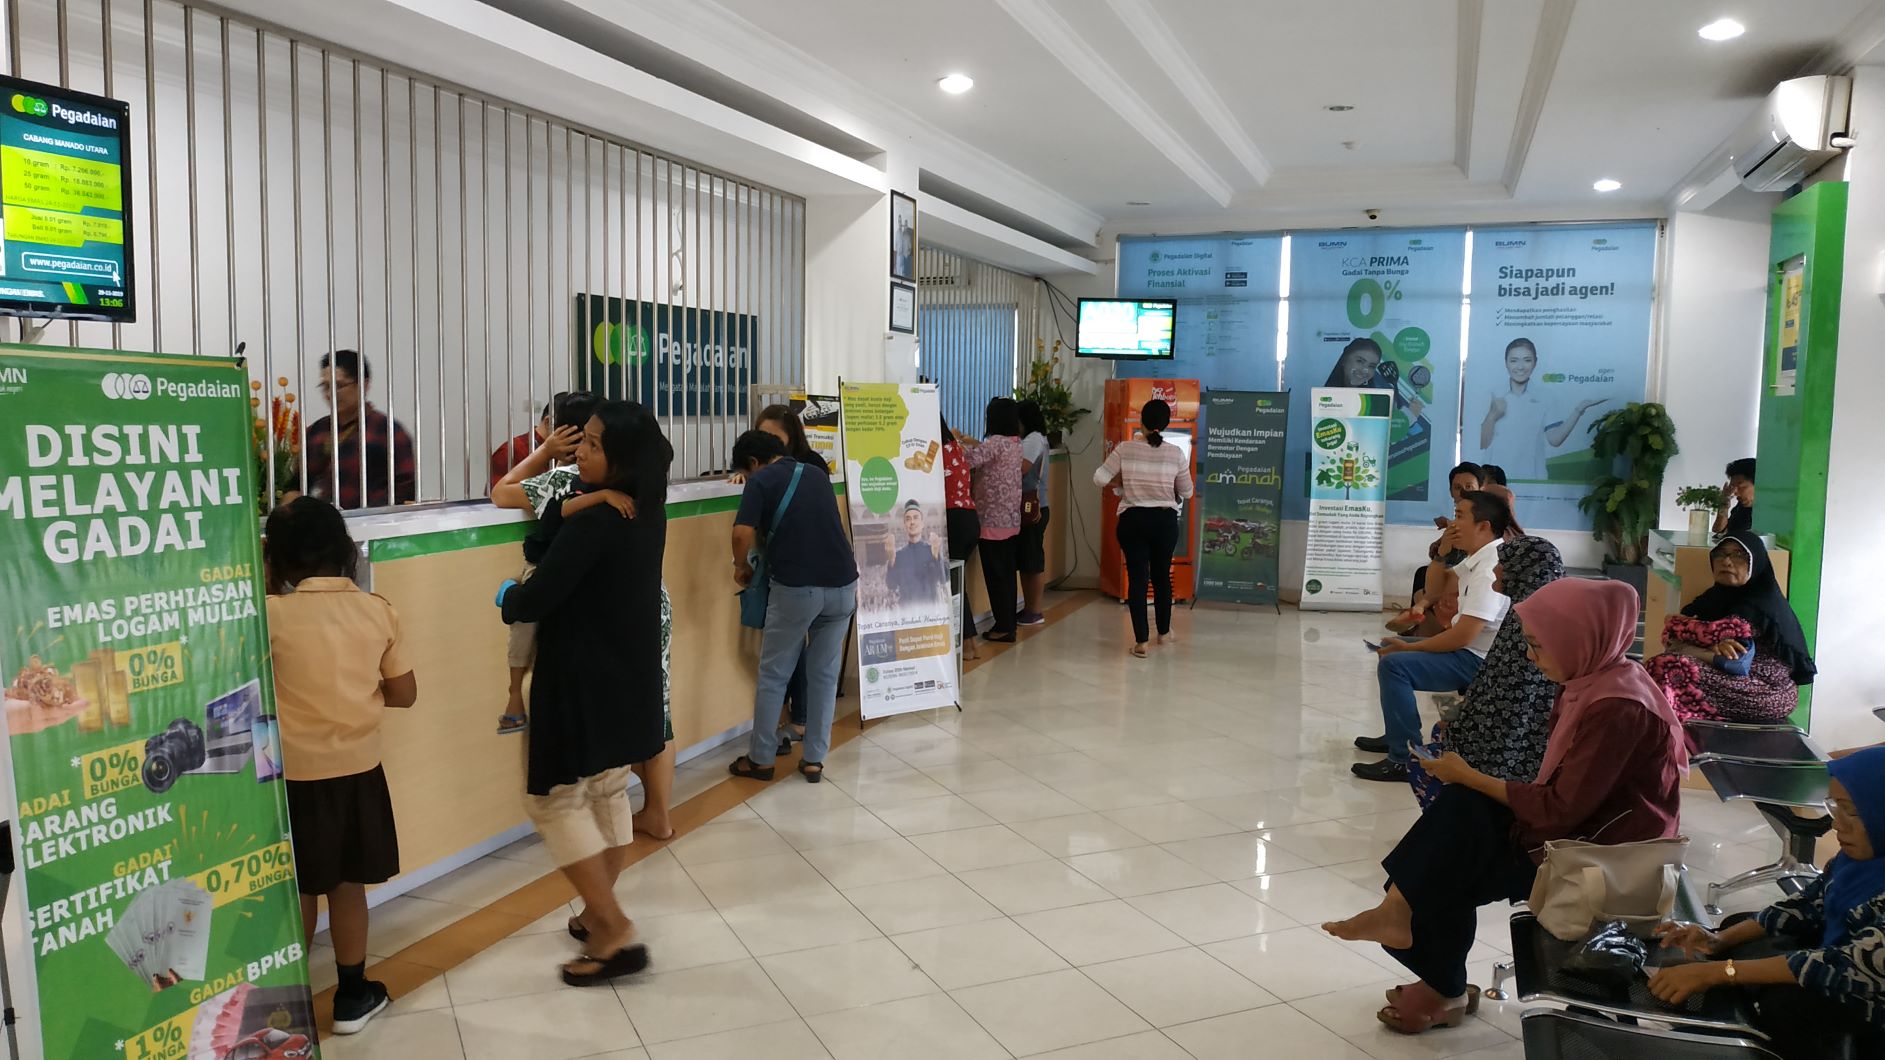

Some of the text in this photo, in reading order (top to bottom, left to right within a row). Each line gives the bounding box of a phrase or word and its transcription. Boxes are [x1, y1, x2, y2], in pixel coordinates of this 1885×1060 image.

[52, 104, 117, 130] Pegadaian
[23, 133, 108, 155] CABANG MANADO UTARA
[32, 160, 49, 169] gram
[33, 172, 49, 180] gram
[29, 257, 112, 273] www.pegadaian.co.id
[1194, 252, 1213, 260] Digital
[1342, 256, 1410, 267] KCA PRIMA
[1147, 267, 1211, 277] Proses Aktivasi
[1364, 268, 1385, 276] Tanpa
[1386, 268, 1410, 276] Bunga
[1498, 265, 1576, 282] Siapapun
[1147, 279, 1186, 288] Finansial
[1497, 282, 1615, 300] bisa jadi agen!
[99, 298, 124, 308] 13:06
[1346, 277, 1403, 329] 0%
[659, 333, 748, 375] Pegadaan
[157, 377, 241, 402] Pegadaian
[1568, 374, 1614, 384] Pegadaian
[1208, 427, 1284, 439] Wujudkan Impian
[1315, 427, 1342, 439] EmasKu
[25, 424, 204, 467] DISINI
[1207, 452, 1243, 460] Pembiayaan
[1235, 445, 1258, 453] Dengan
[1205, 466, 1281, 490] amanah
[1237, 465, 1272, 473] Pegadaian
[0, 468, 243, 519] MELAYANI
[43, 512, 206, 564] GADAI
[200, 563, 252, 583] GADAI
[47, 579, 253, 629] EMAS PERHIASAN
[98, 598, 258, 643] LOGAM MULIA
[128, 649, 176, 677] 0%
[132, 670, 179, 689] BUNGA
[89, 750, 139, 783] 0%
[90, 773, 140, 797] BUNGA
[19, 789, 72, 819] ADAI
[20, 797, 117, 846] ARANG
[23, 802, 174, 870] LEKTRONIK
[112, 845, 173, 878] GADAI
[206, 845, 291, 893] 0,70%
[249, 869, 293, 891] BUNGA
[190, 942, 304, 1004] GADAI BPKB
[135, 1020, 182, 1060] 1%
[148, 1041, 186, 1060] NGA
